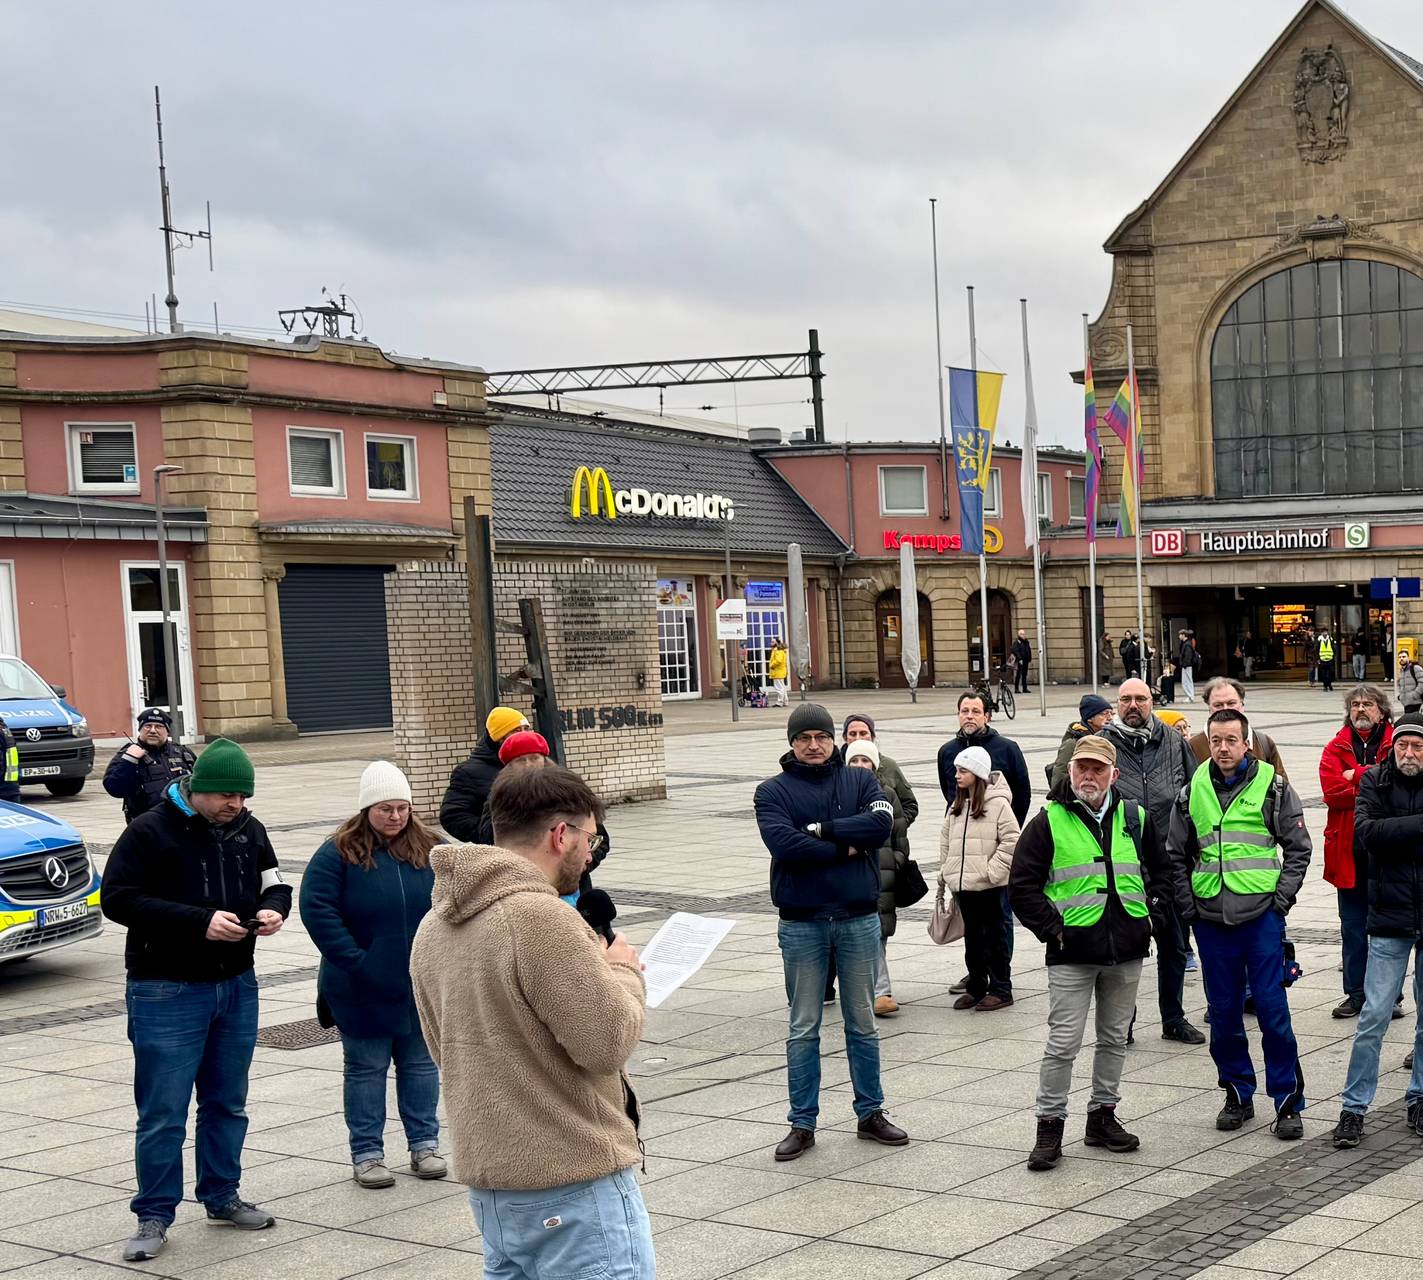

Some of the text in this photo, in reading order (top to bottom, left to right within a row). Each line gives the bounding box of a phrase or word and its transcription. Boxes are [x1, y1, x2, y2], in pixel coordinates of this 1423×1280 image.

[571, 465, 735, 521] McDonald's
[1154, 528, 1328, 554] DB Hauptbahnhof
